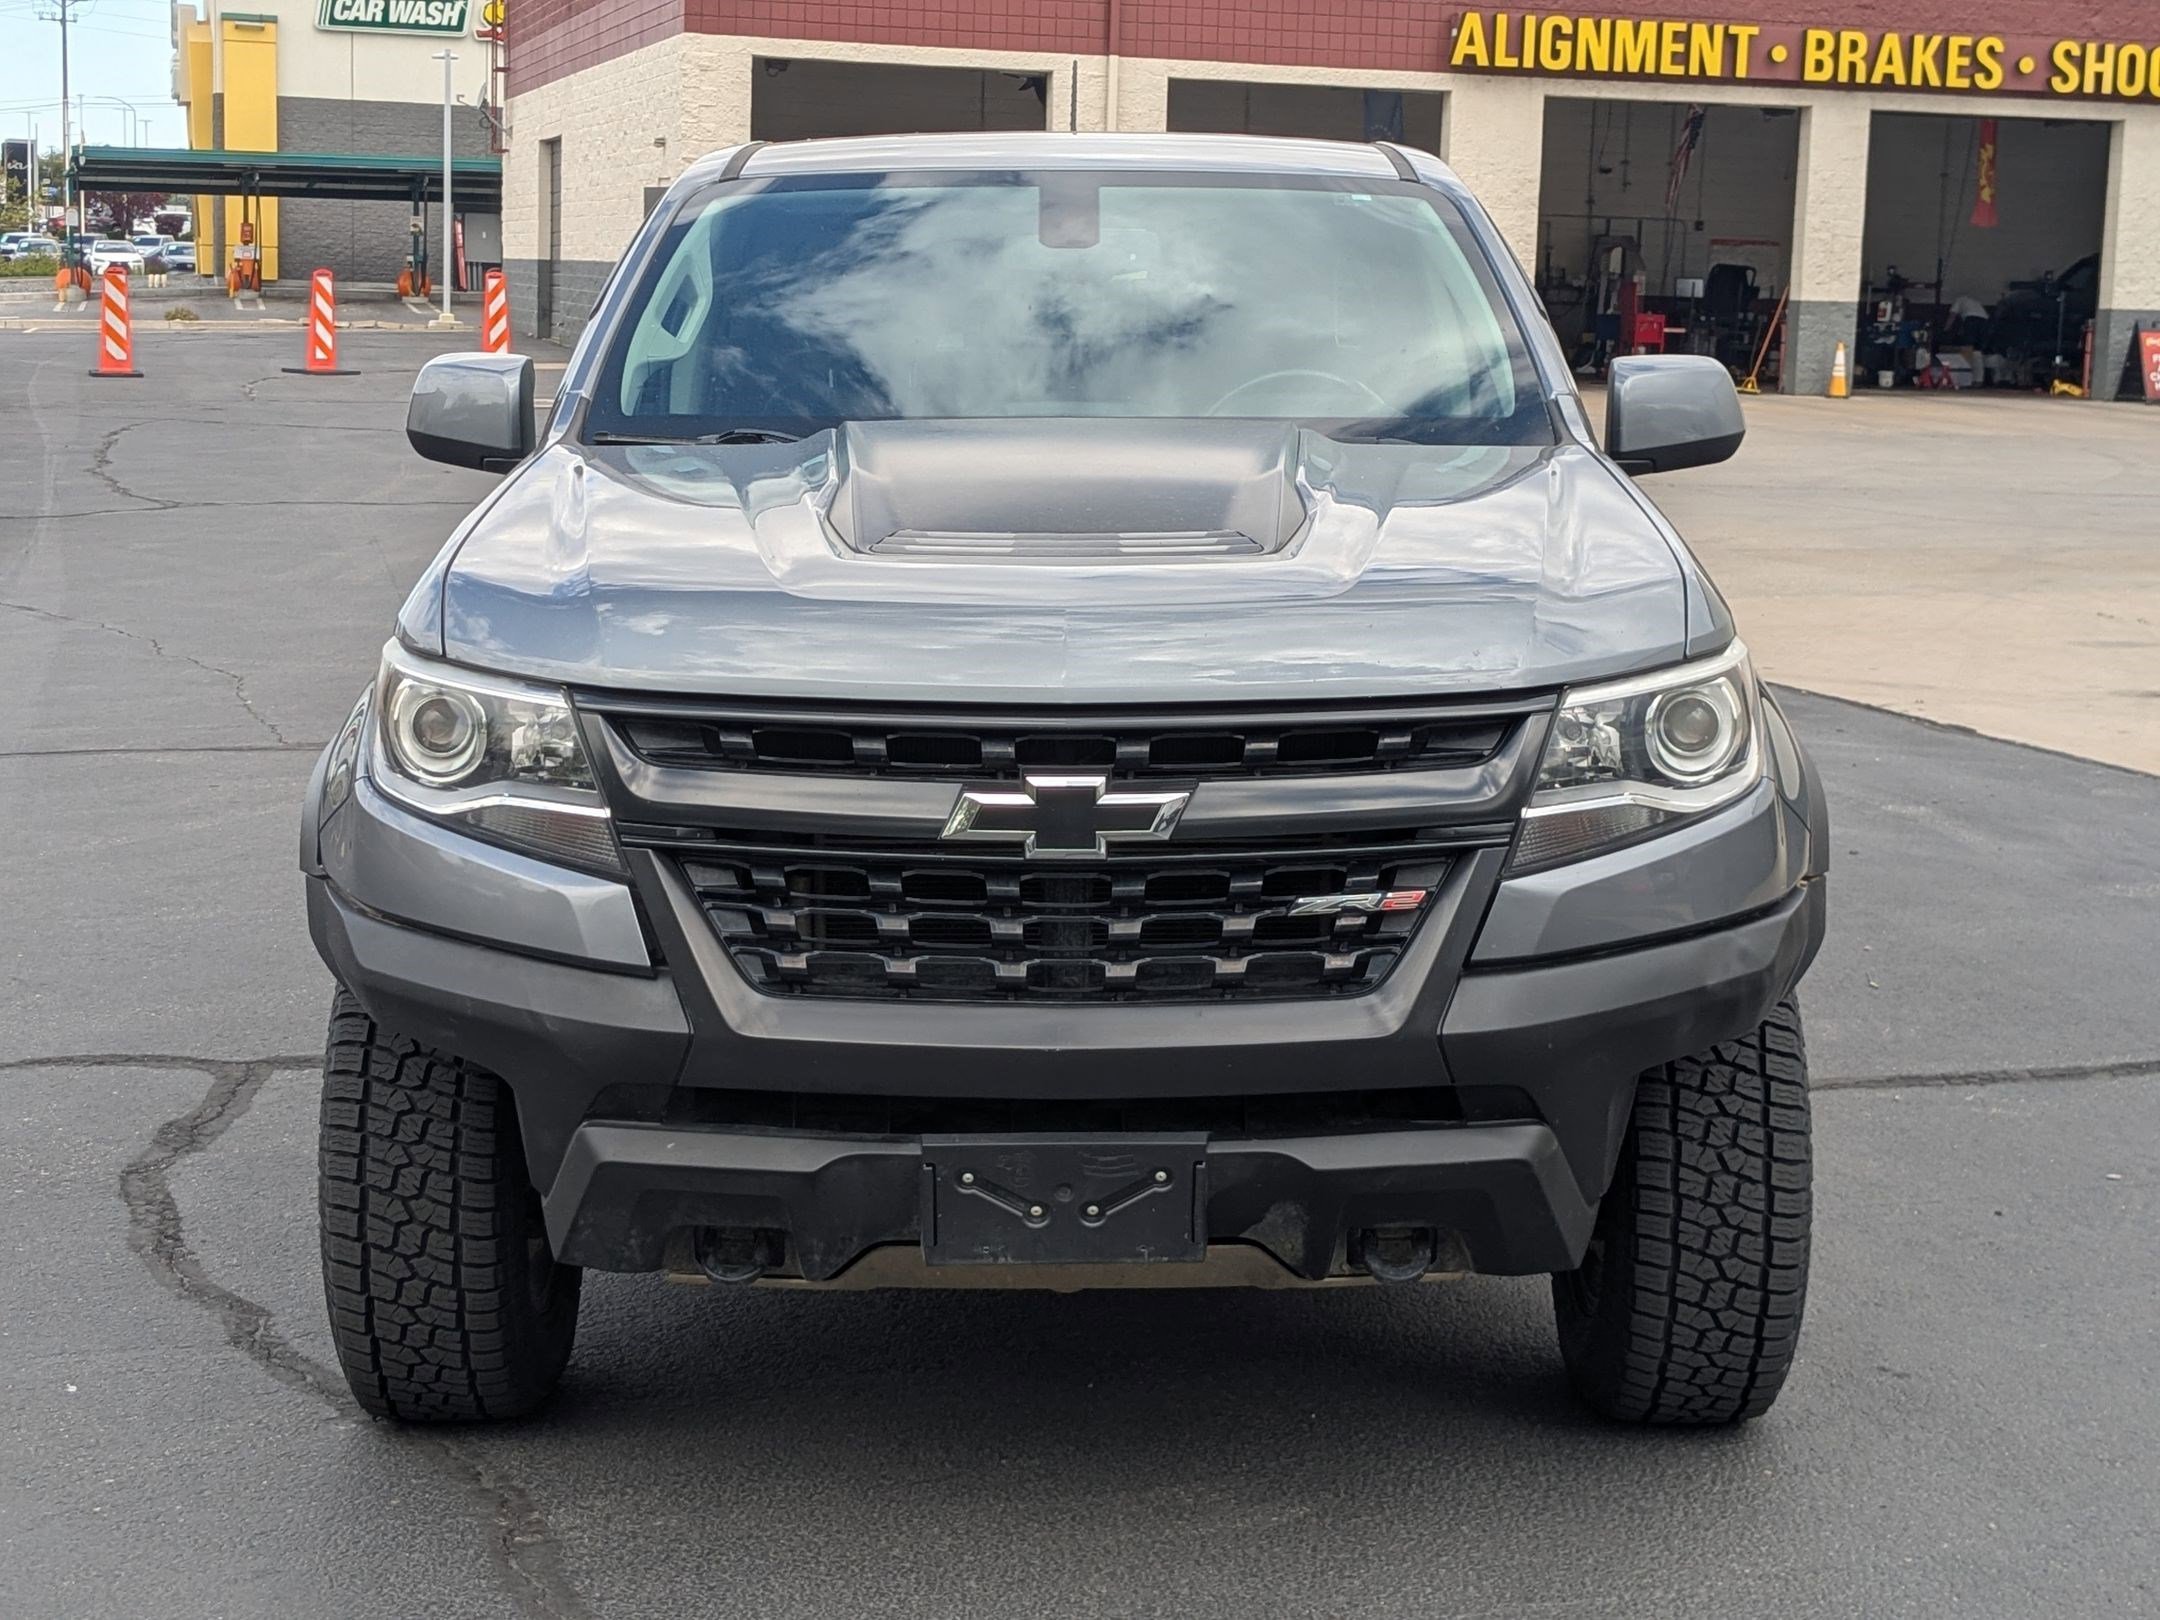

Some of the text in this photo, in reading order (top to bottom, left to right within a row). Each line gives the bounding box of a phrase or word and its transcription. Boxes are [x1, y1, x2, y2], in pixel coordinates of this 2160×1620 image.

[334, 0, 462, 26] CAR WASH
[1450, 12, 1759, 78] ALIGNMENT
[1803, 29, 2004, 90] BRAKES
[1288, 890, 1426, 916] ZR2
